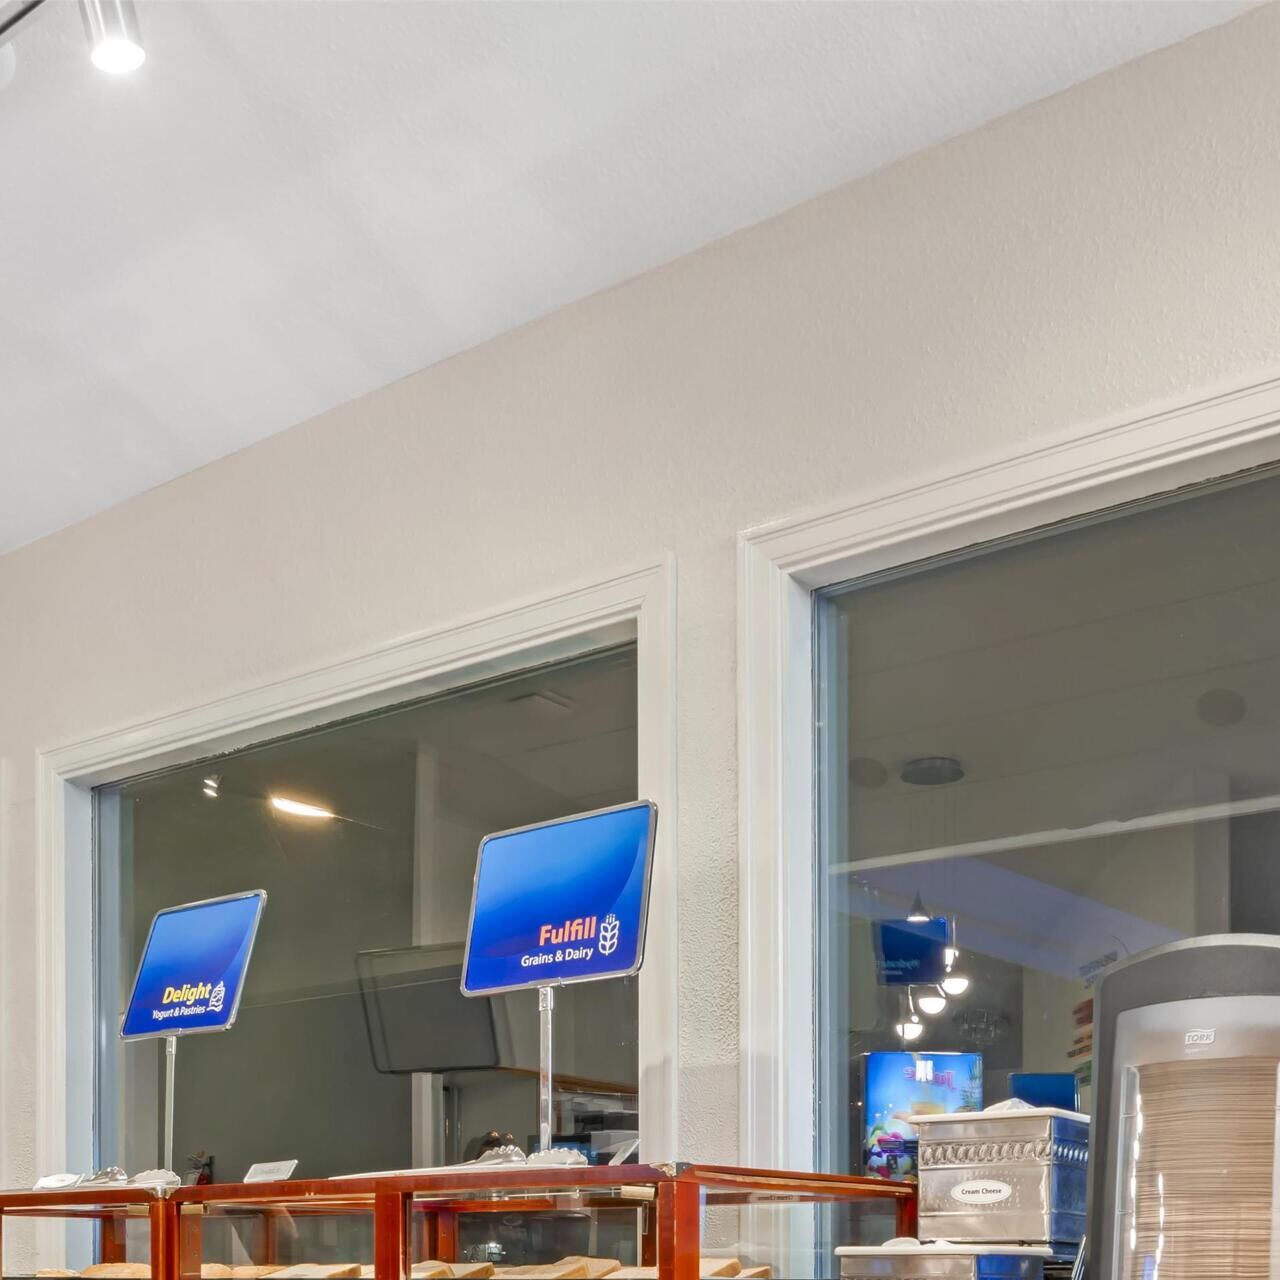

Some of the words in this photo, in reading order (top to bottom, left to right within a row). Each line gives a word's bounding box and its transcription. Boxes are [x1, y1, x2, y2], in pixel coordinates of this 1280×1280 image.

[539, 916, 597, 946] Fulfill
[521, 953, 554, 967] Grains
[555, 950, 564, 962] &
[565, 947, 594, 961] Dairy
[162, 982, 212, 1005] Delight
[152, 1009, 174, 1021] Yogurt
[173, 1006, 180, 1017] &
[180, 1005, 207, 1016] Pastries
[1185, 1031, 1216, 1044] TORK
[981, 1187, 1002, 1195] Cheese
